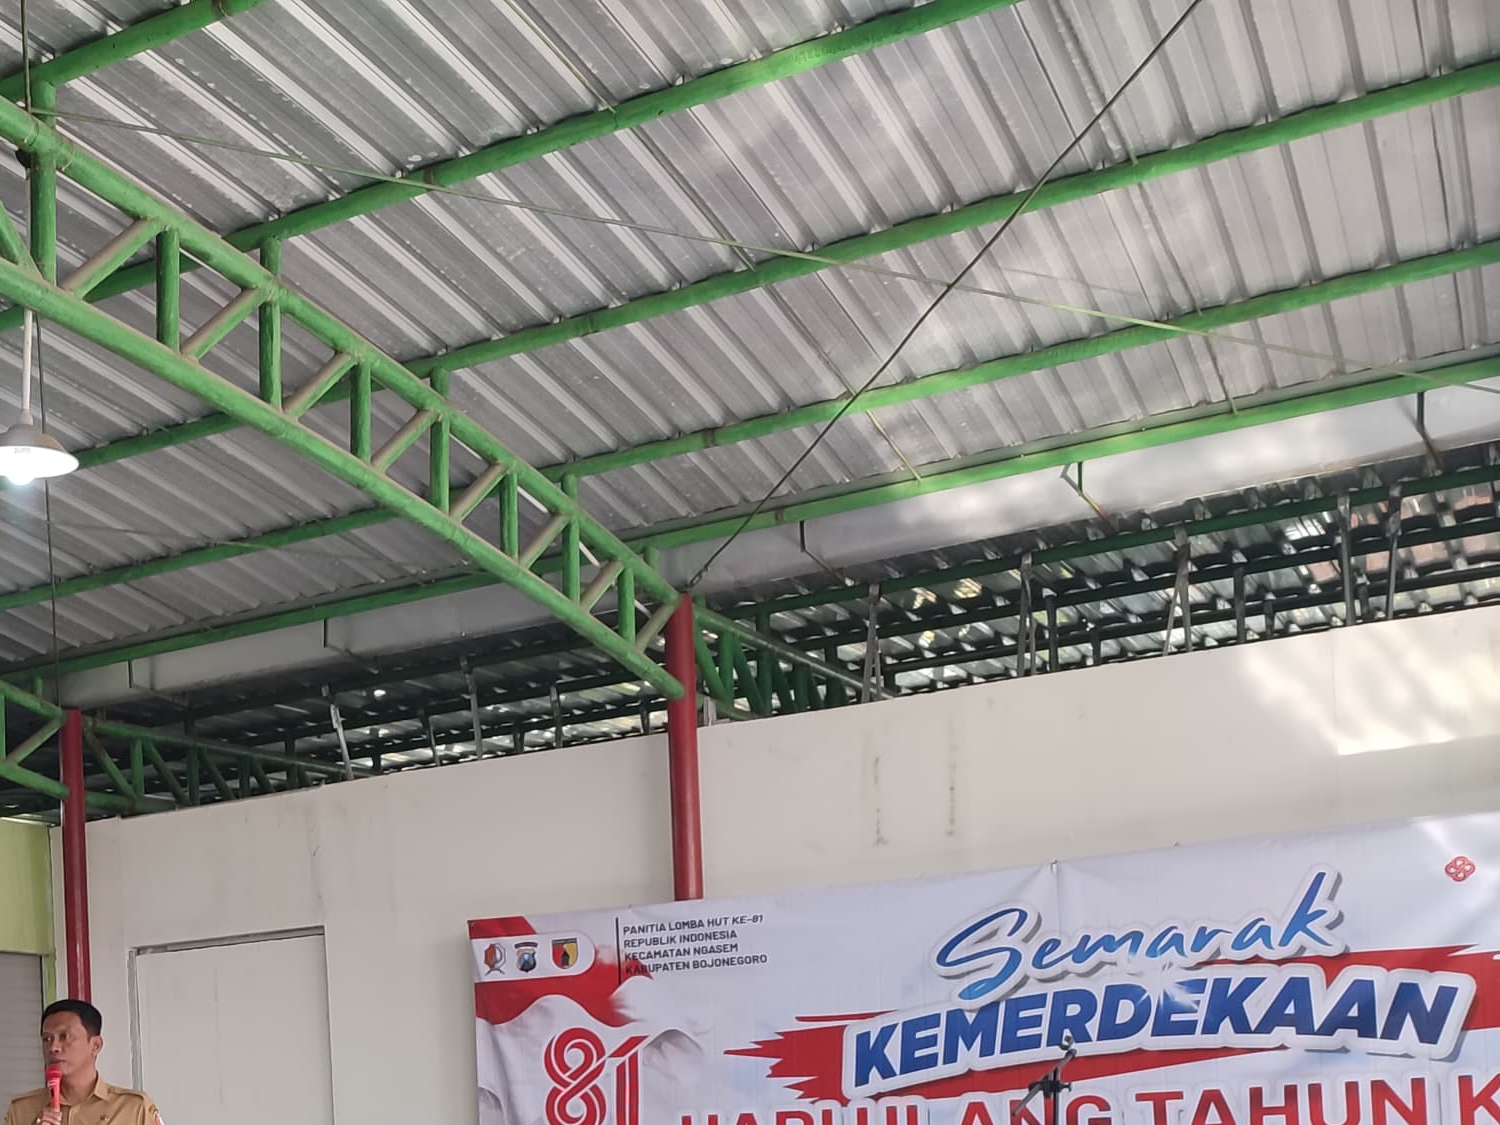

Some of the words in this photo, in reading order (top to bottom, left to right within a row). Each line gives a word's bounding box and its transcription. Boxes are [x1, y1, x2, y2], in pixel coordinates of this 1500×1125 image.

[623, 923, 666, 936] PANITIA
[668, 919, 705, 931] LOMBA
[707, 917, 730, 927] HUT
[731, 914, 763, 925] KE-81
[623, 935, 676, 949] REPUBLIK
[679, 930, 737, 943] INDONESIA
[936, 871, 1335, 1001] Semarak
[625, 948, 692, 961] KECAMATAN
[693, 943, 738, 955] NGASEM
[626, 960, 690, 974] KABUPATEN
[692, 954, 767, 969] BOJONEGORO
[853, 975, 1458, 1088] KEMERDEKAAN
